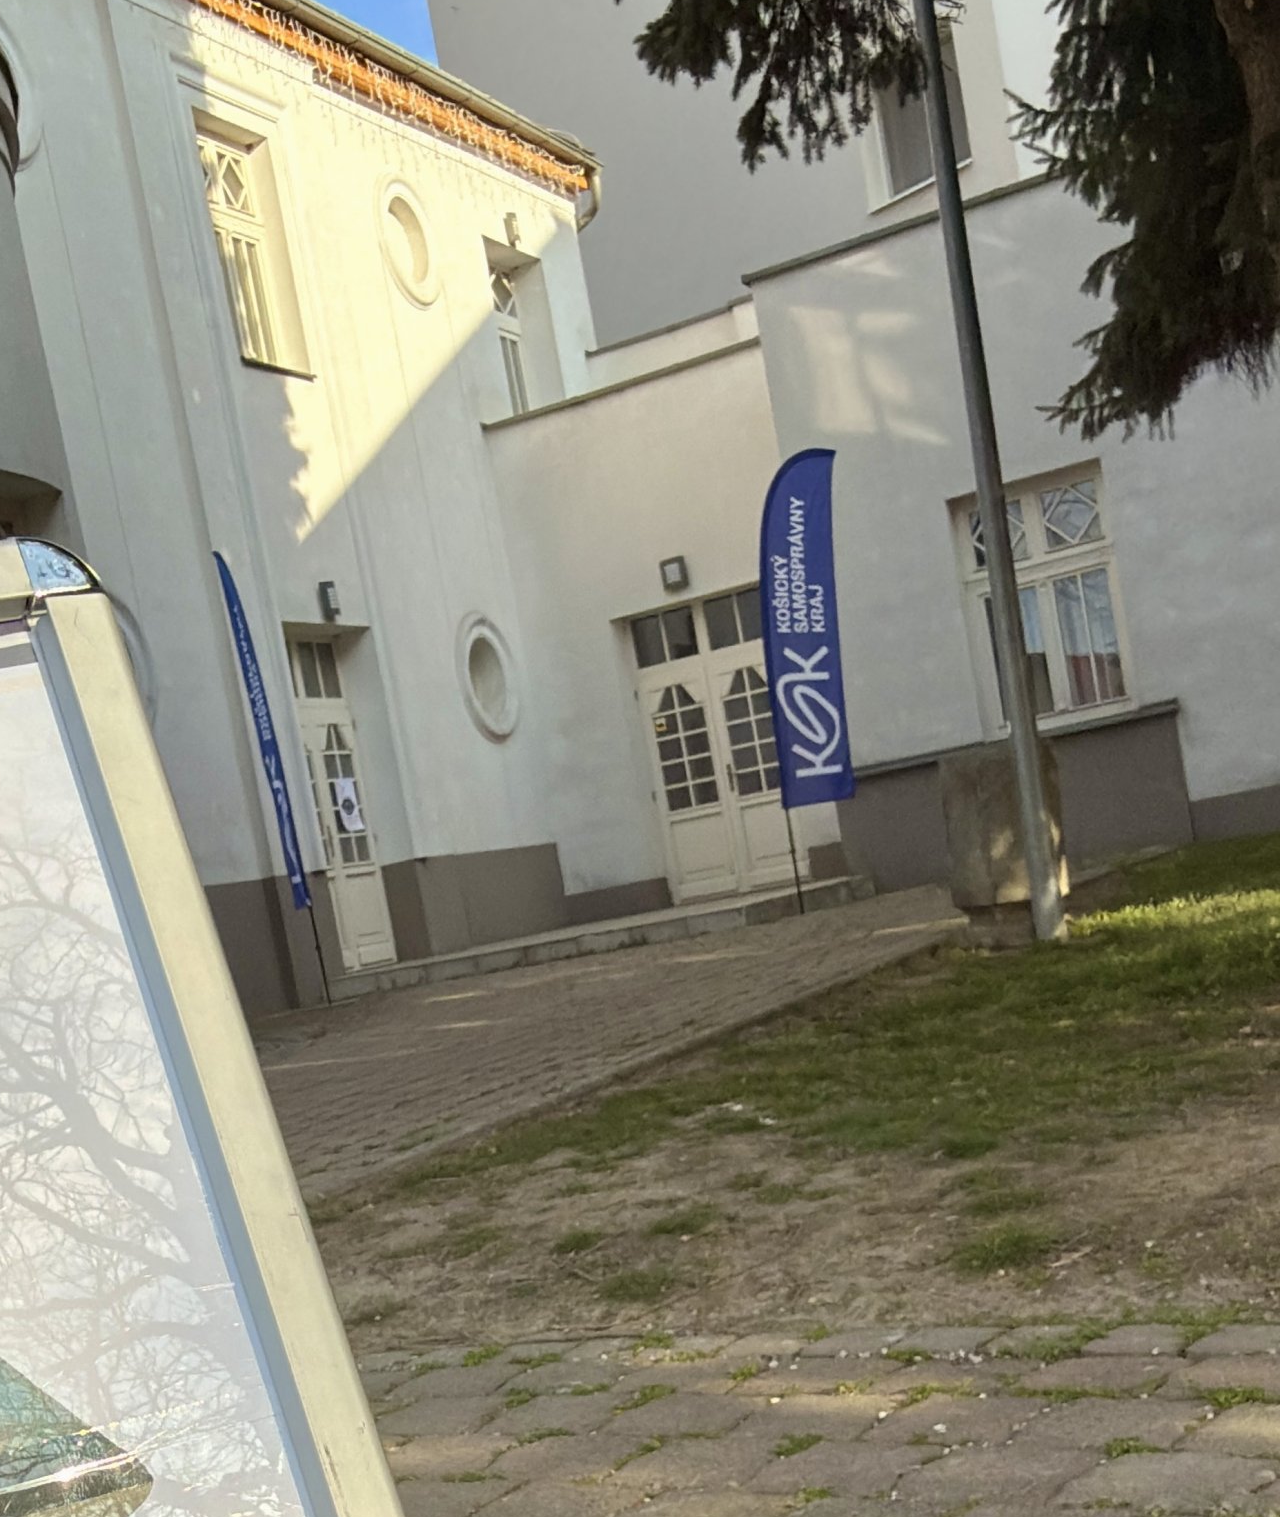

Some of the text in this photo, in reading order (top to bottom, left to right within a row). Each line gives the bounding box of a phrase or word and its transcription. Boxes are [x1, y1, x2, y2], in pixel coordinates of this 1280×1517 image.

[771, 555, 792, 634] KOŠICKÝ
[790, 496, 810, 634] SAMOSPRÁVNY
[811, 584, 827, 633] KRAJ
